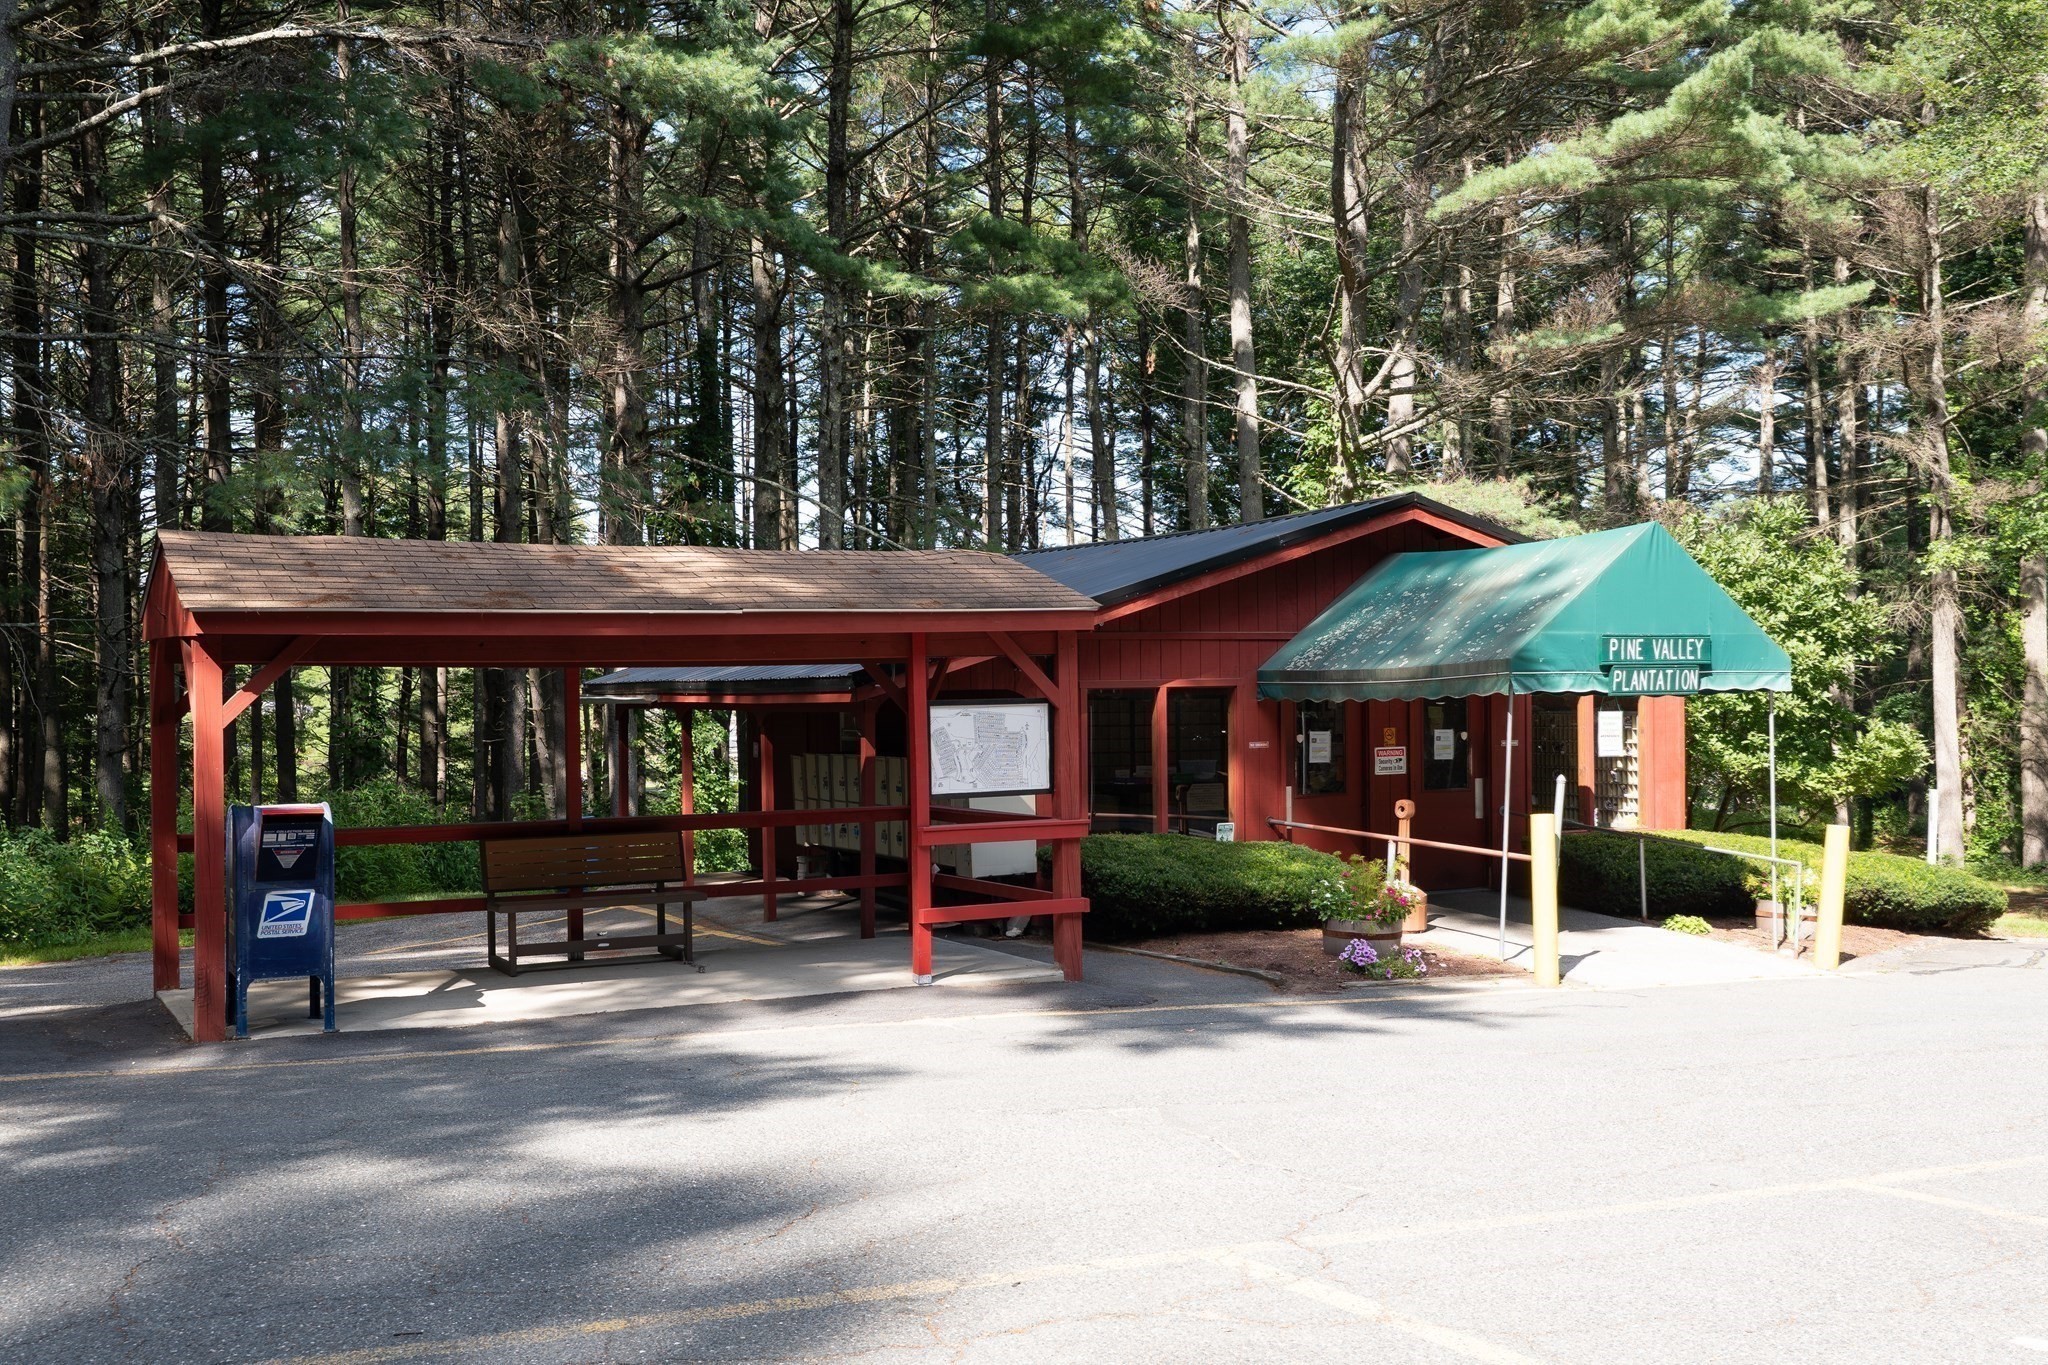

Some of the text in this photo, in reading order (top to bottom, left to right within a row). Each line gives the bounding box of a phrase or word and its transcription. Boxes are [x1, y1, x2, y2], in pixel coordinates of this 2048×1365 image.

[1609, 638, 1704, 661] PINE VALLEY
[1612, 669, 1699, 692] PLANTATION
